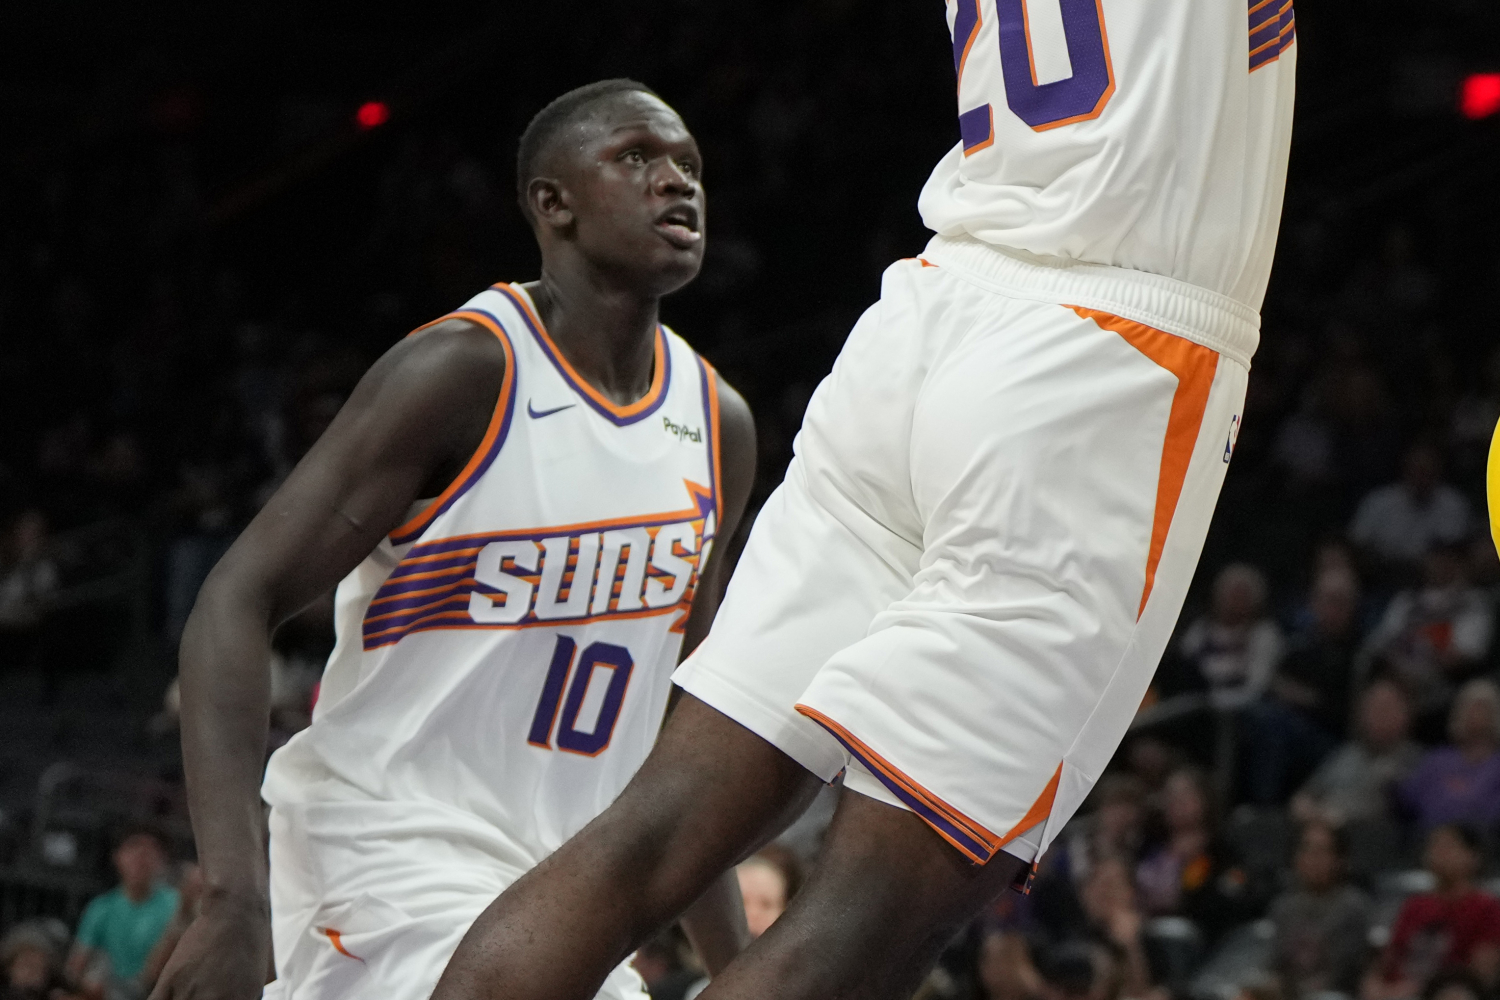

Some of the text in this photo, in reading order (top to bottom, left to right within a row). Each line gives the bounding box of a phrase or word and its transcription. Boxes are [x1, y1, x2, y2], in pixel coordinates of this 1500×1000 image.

[662, 416, 702, 443] PayPal
[467, 520, 696, 624] SUNS
[526, 632, 635, 758] 10
